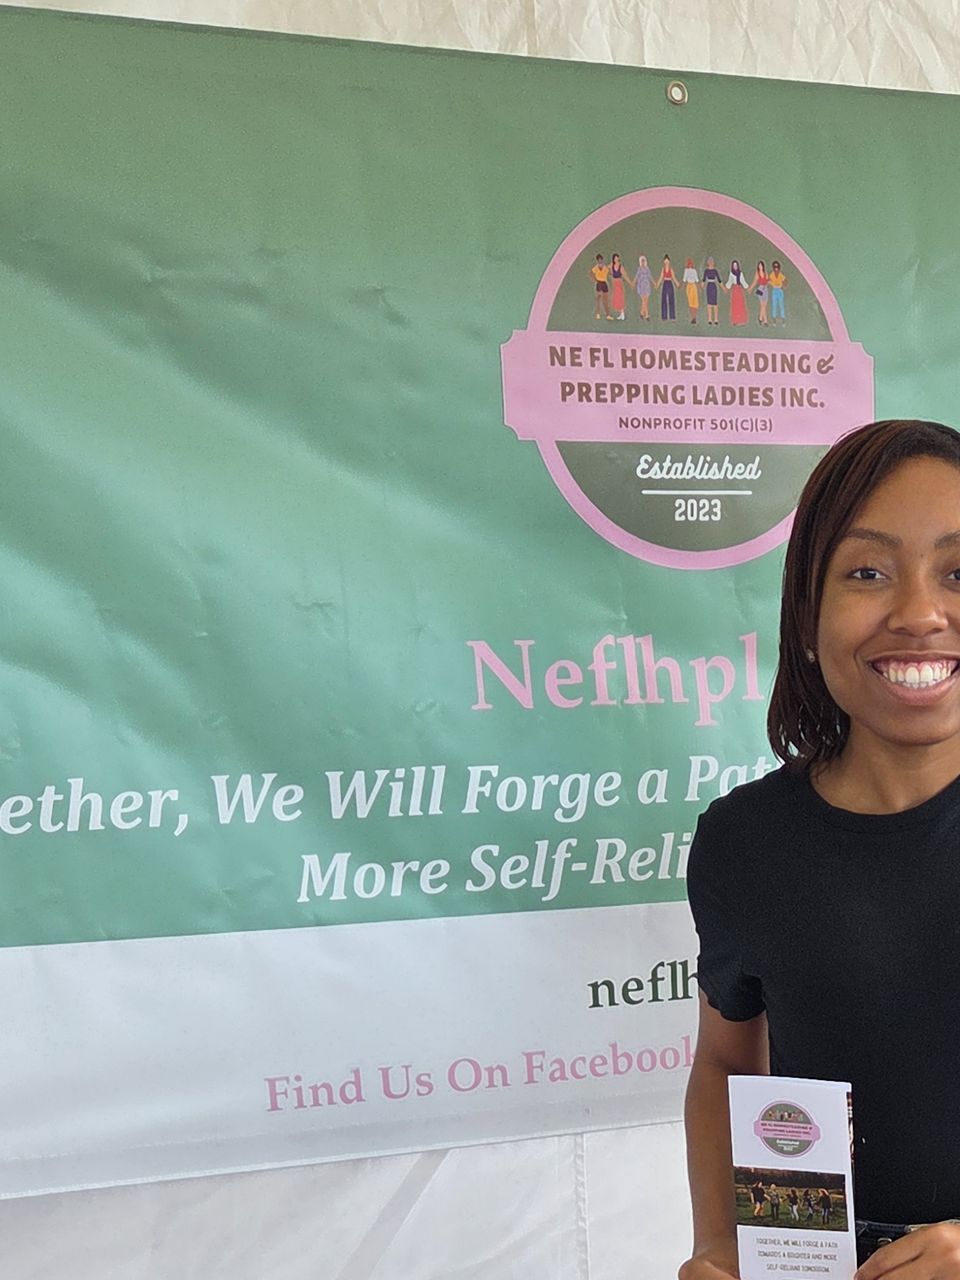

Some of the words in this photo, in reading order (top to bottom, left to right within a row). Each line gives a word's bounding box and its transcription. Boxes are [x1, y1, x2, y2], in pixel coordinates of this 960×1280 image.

[549, 345, 582, 367] NE
[589, 347, 614, 368] FL
[621, 348, 811, 374] HOMESTEADING
[816, 353, 834, 374] &
[560, 381, 685, 405] PREPPING
[692, 385, 774, 407] LADIES
[780, 387, 825, 408] INC.
[618, 416, 706, 431] NONPROFIT
[710, 418, 773, 432] 501(C)(3)
[636, 454, 762, 480] Established
[674, 498, 722, 521] 2023
[0, 777, 188, 837] ether,
[210, 773, 304, 825] We
[325, 765, 446, 819] Will
[461, 764, 622, 823] Forge
[637, 768, 668, 804] a
[684, 755, 776, 802] Pat
[297, 852, 450, 903] More
[264, 1066, 366, 1112] Find
[377, 1064, 434, 1100] Us
[447, 1057, 511, 1092] On
